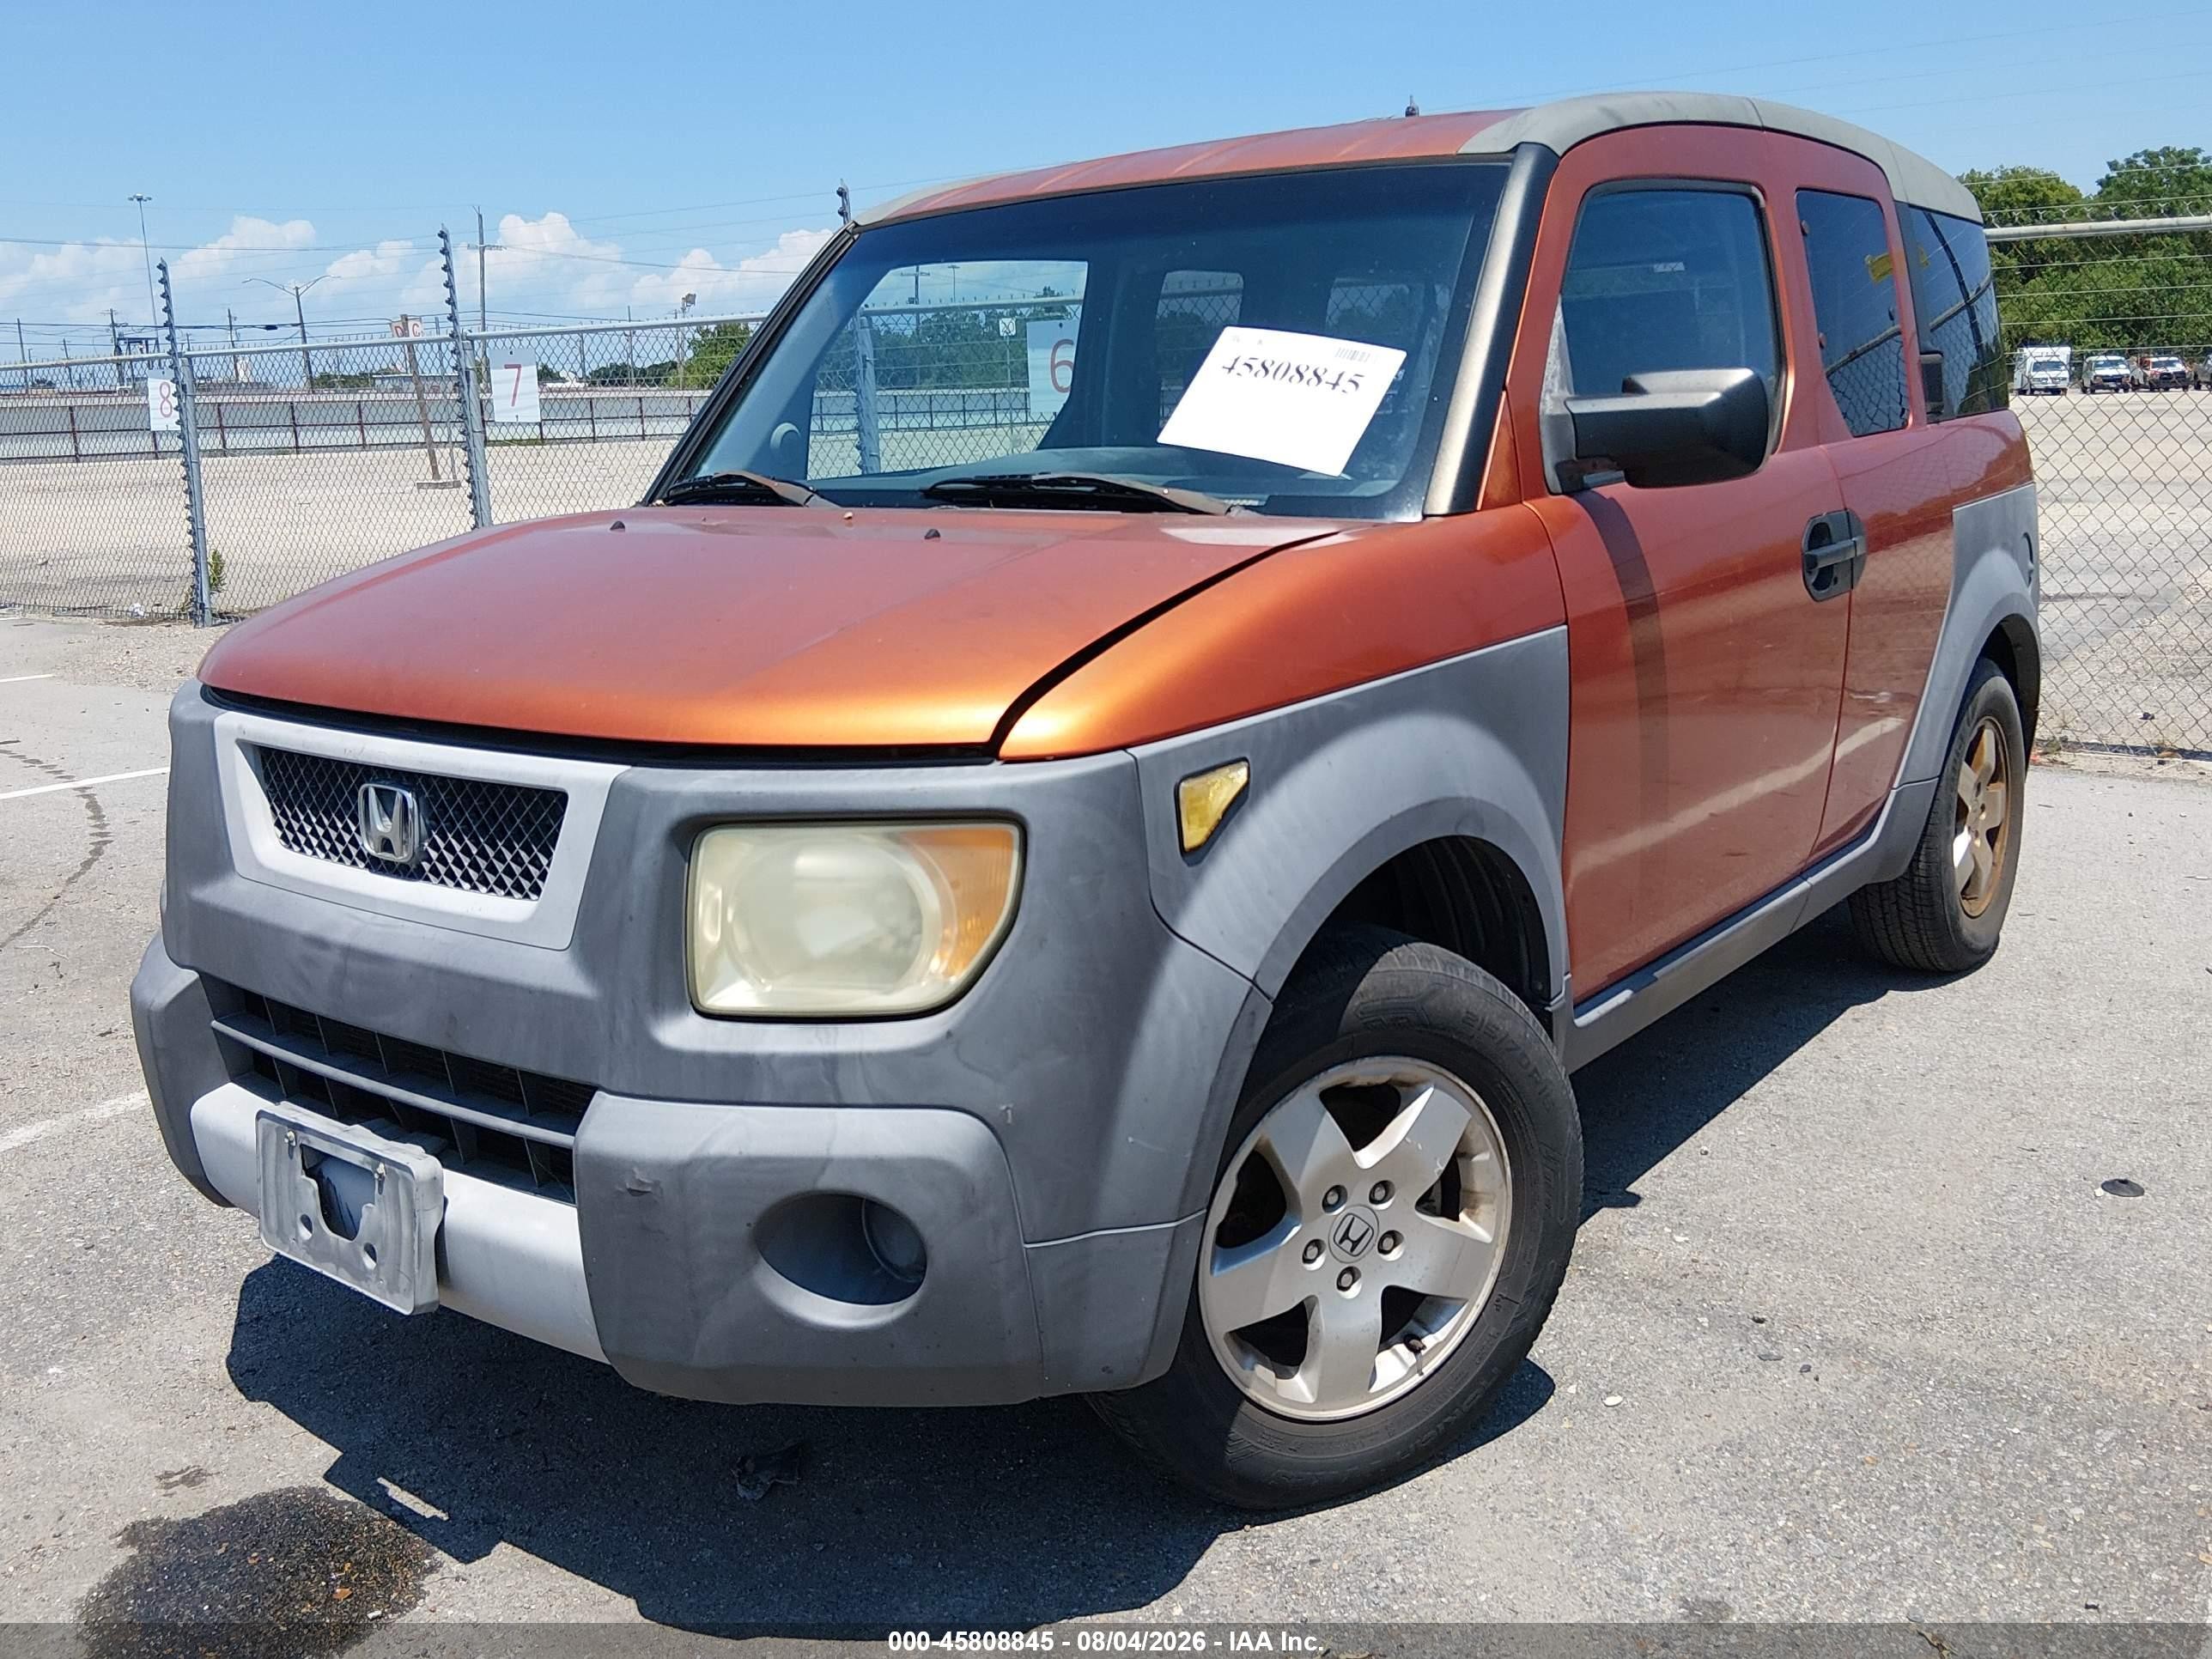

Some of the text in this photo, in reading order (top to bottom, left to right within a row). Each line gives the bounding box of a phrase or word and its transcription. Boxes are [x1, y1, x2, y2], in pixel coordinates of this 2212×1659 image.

[504, 363, 522, 407] 7
[1050, 338, 1074, 393] 6
[1222, 356, 1365, 394] 45808845
[159, 381, 173, 418] 8
